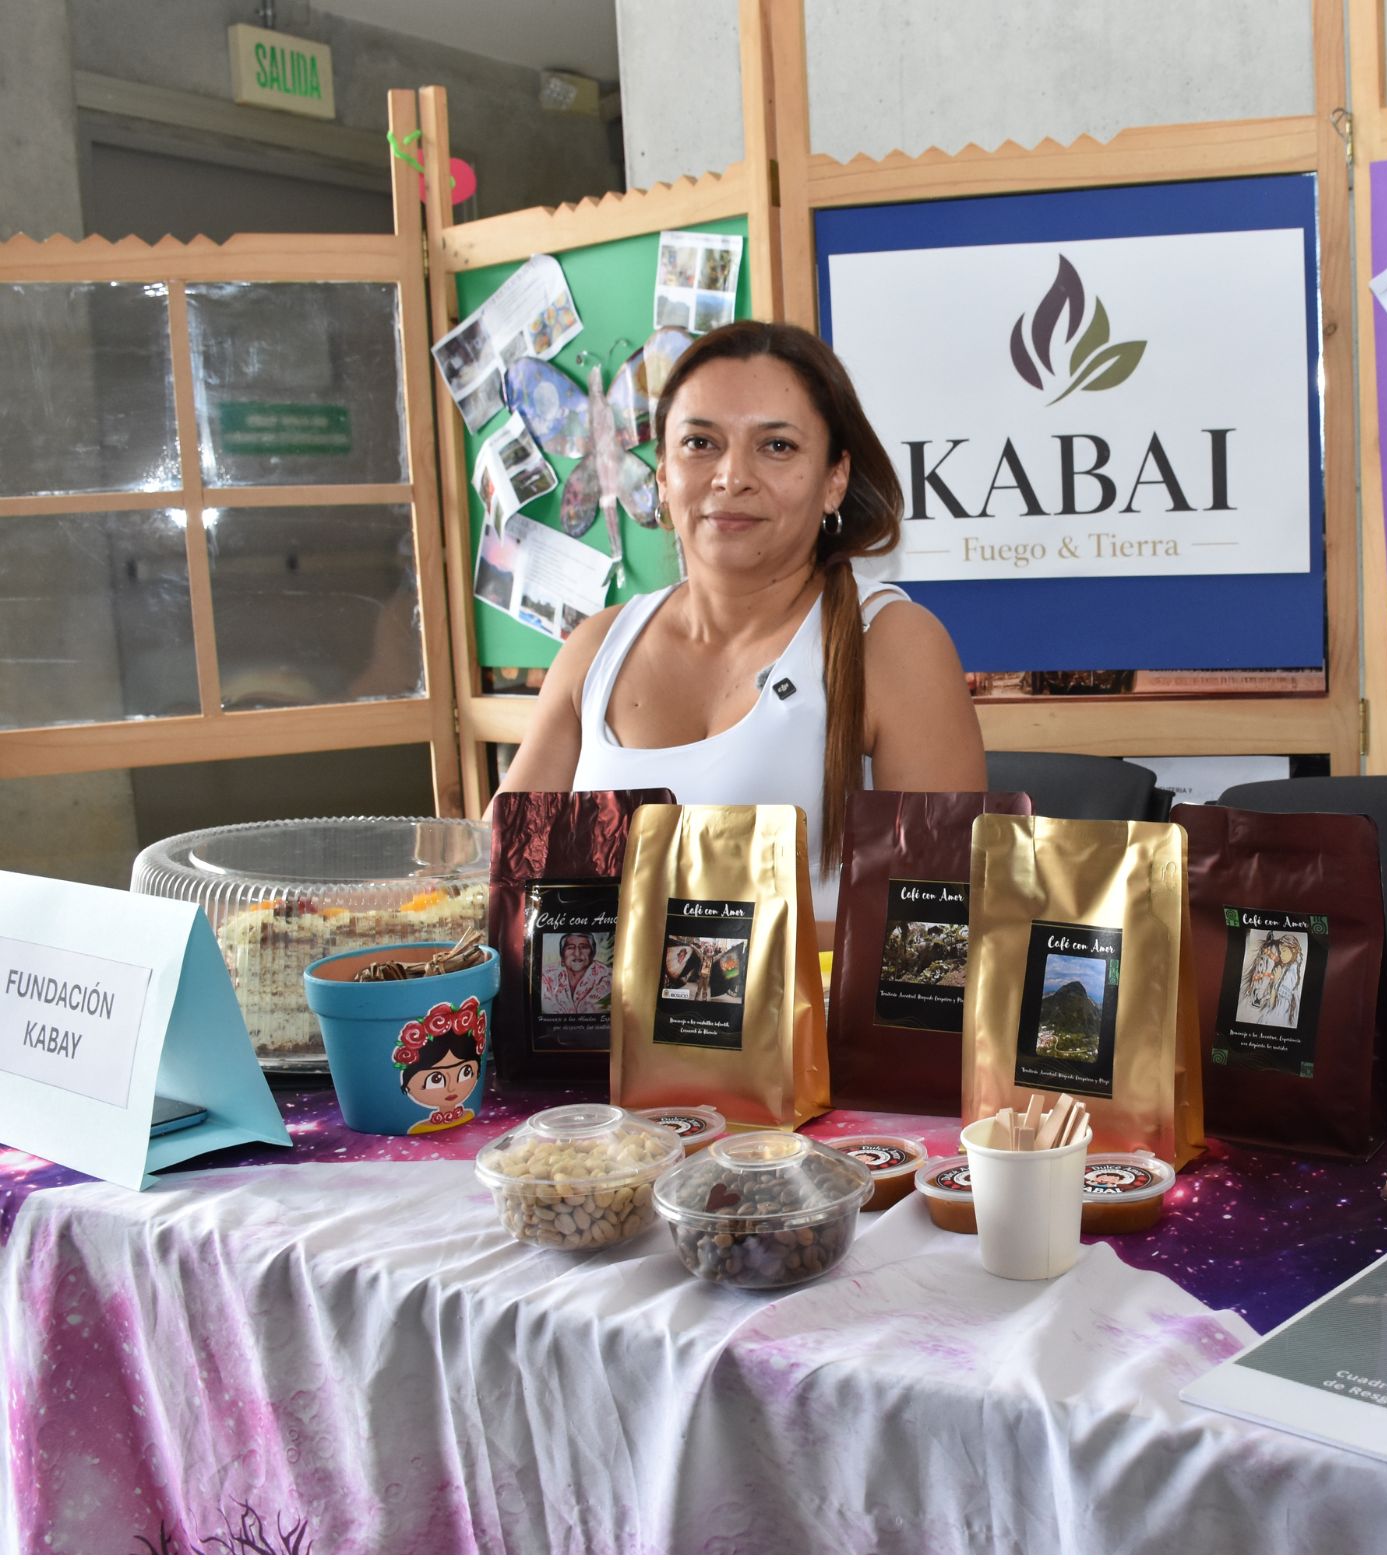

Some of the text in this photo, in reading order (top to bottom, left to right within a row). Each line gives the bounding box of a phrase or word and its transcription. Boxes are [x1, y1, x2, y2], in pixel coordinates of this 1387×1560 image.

[254, 42, 322, 99] SALIDA
[901, 429, 1238, 521] KABAI
[962, 532, 1180, 567] Fuego & Tierra
[900, 886, 964, 902] Café con Amor
[1242, 913, 1309, 928] Café con Amor
[1048, 935, 1115, 954] Café con Amor
[5, 968, 115, 1020] FUNDACIÓN
[23, 1025, 83, 1060] KABAY
[1323, 1378, 1344, 1391] de
